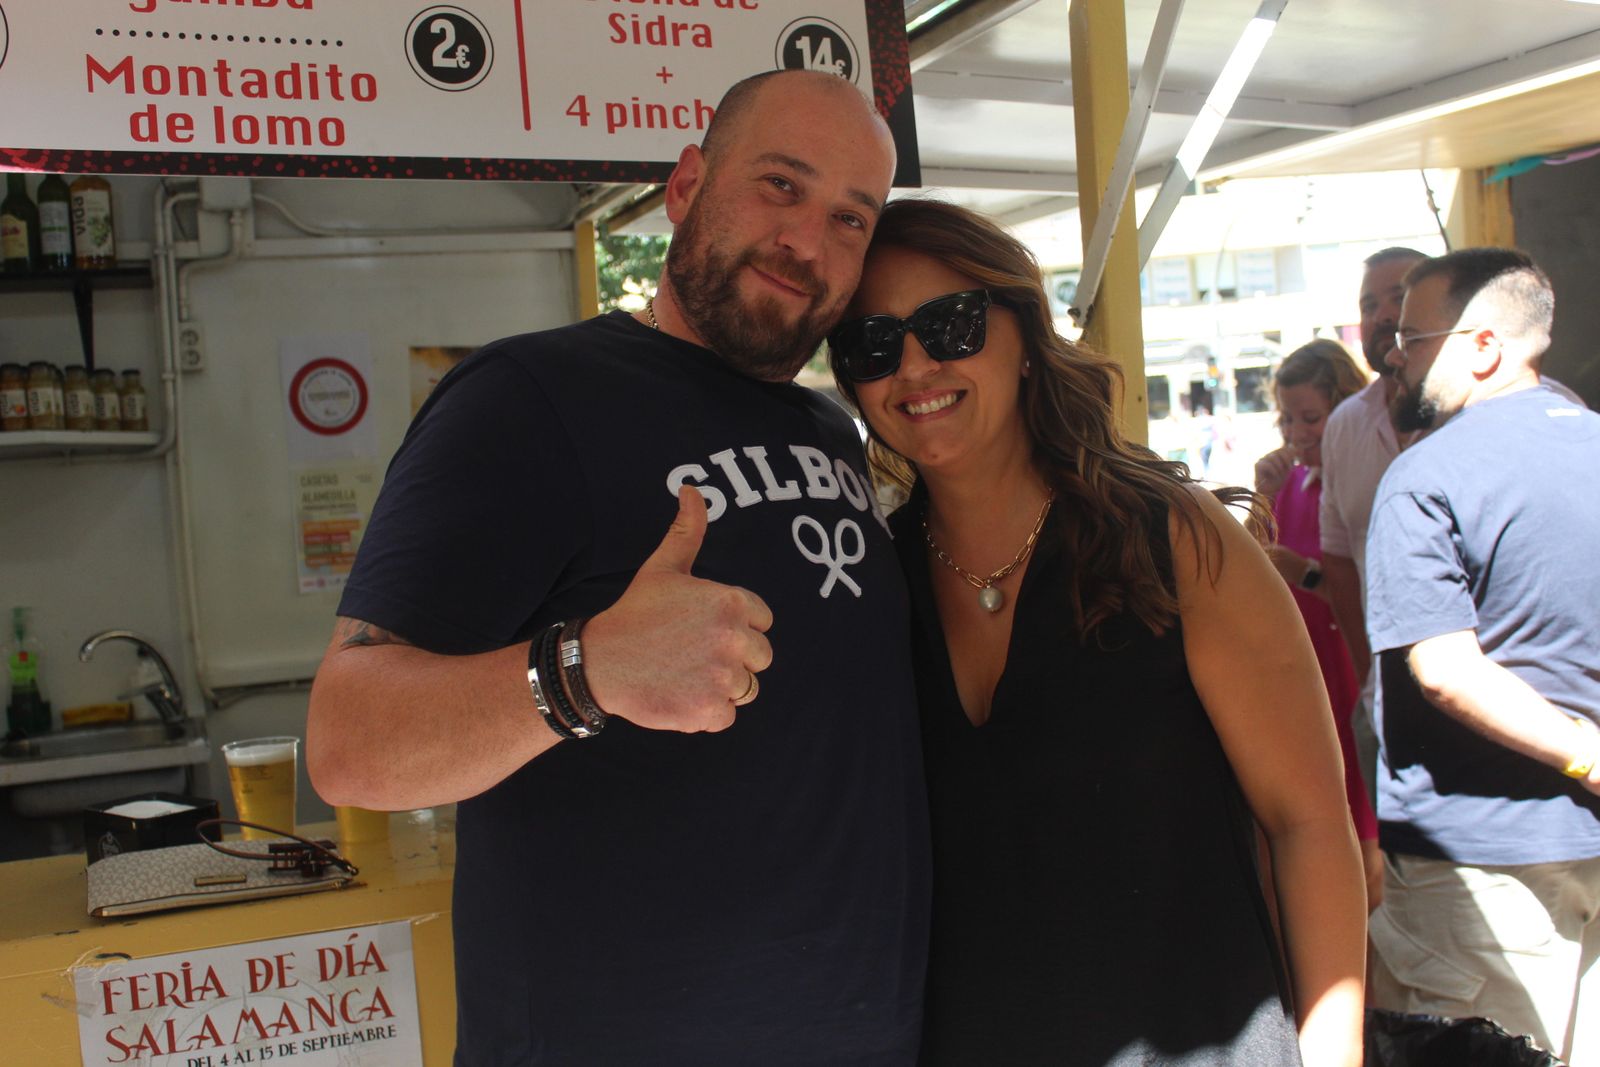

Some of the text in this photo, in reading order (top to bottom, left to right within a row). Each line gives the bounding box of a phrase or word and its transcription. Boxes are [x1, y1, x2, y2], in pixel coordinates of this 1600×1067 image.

[429, 18, 471, 70] 2€
[608, 12, 713, 49] Sidra
[85, 53, 378, 103] Montadito
[129, 103, 347, 147] de lomo
[565, 94, 716, 135] 4 pinch
[73, 196, 86, 236] vida
[99, 932, 389, 1017] FERIA DE DÍA
[105, 985, 398, 1064] SALAMANCA
[187, 1024, 398, 1067] DEL 4 AL 15 DE SEPTIEMBRE
